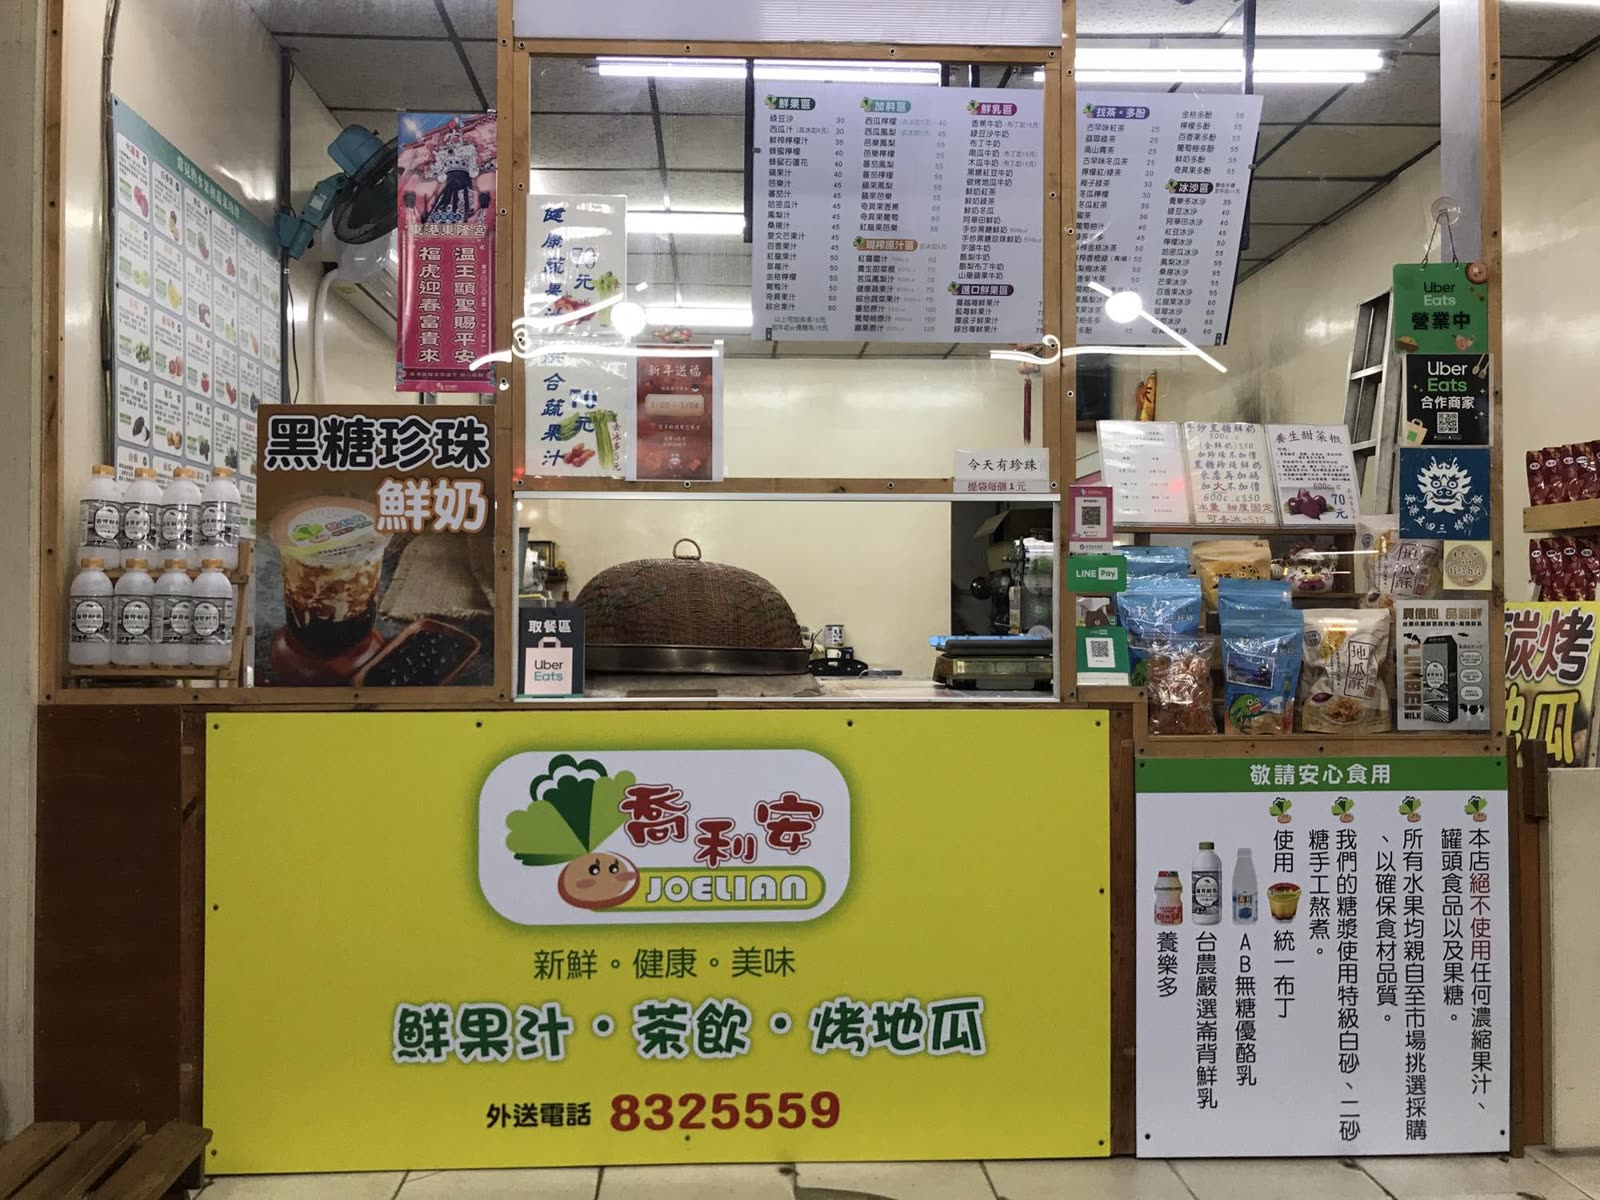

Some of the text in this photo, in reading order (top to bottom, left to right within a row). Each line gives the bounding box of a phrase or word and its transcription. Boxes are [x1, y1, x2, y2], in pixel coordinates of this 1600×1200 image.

[778, 98, 811, 109] 鮮果區
[874, 102, 906, 112] 加料區
[980, 104, 1012, 114] 鮮乳區
[770, 114, 794, 123] 綠豆沙
[865, 117, 897, 125] 西瓜檸檬
[769, 125, 793, 133] 西瓜汁
[1087, 124, 1125, 132] 古早味紅茶
[969, 140, 1001, 148] 布丁牛奶
[968, 159, 999, 167] 木瓜牛奶
[1178, 183, 1208, 193] 冰沙區
[1078, 201, 1107, 209] 冬瓜紅茶
[767, 211, 790, 219] 鳳梨汁
[410, 224, 486, 237] 東港東隆宮
[1165, 228, 1195, 236] 紅豆冰沙
[767, 242, 797, 250] 百香果汁
[573, 274, 596, 291] 元
[1158, 278, 1187, 286] 芒果冰沙
[1423, 282, 1456, 294] Uber
[961, 286, 1008, 295] 進口鮮果區
[1156, 288, 1193, 296] 百香果冰沙
[418, 246, 442, 363] 福虎迎春富貴來
[1423, 295, 1457, 307] Eats
[1411, 311, 1471, 331] 營業中
[1427, 361, 1468, 376] Uber
[1427, 378, 1468, 392] Eats
[1420, 395, 1475, 410] 合作商家
[573, 416, 595, 433] 元
[264, 415, 490, 471] 黑糖珍珠
[967, 458, 1038, 472] 今天有珍珠
[376, 479, 488, 532] 鮮奶
[1331, 494, 1346, 505] 70
[1335, 509, 1348, 519] 元
[1076, 569, 1116, 579] LINE Pay
[527, 619, 573, 634] 取餐區
[533, 659, 563, 671] Uber
[1347, 644, 1369, 690] 地瓜酥
[533, 671, 564, 682] Eats
[1404, 712, 1422, 720] MILK
[1249, 763, 1393, 787] 敬請安心食用
[618, 783, 823, 869] 喬利安
[1273, 828, 1295, 873] 使用
[645, 874, 809, 903] JOELIAN
[1308, 828, 1331, 956] 糖手工熬煮。
[1440, 827, 1465, 1022] 罐頭食品以及果糖。
[1156, 930, 1179, 998] 養樂多
[1467, 828, 1493, 1112] 本店絕不使用任何濃縮果汁、
[1273, 929, 1296, 1018] 統一布丁
[1335, 828, 1361, 1142] 我們的糖漿使用特級白砂、二砂
[1401, 828, 1427, 1141] 所有水果均親自至市場挑選採購
[1234, 935, 1257, 1087] AB無糖優酪乳
[1195, 930, 1219, 1110] 台農嚴選崙背鮮乳
[486, 1091, 841, 1132] 外送電話 8325559
